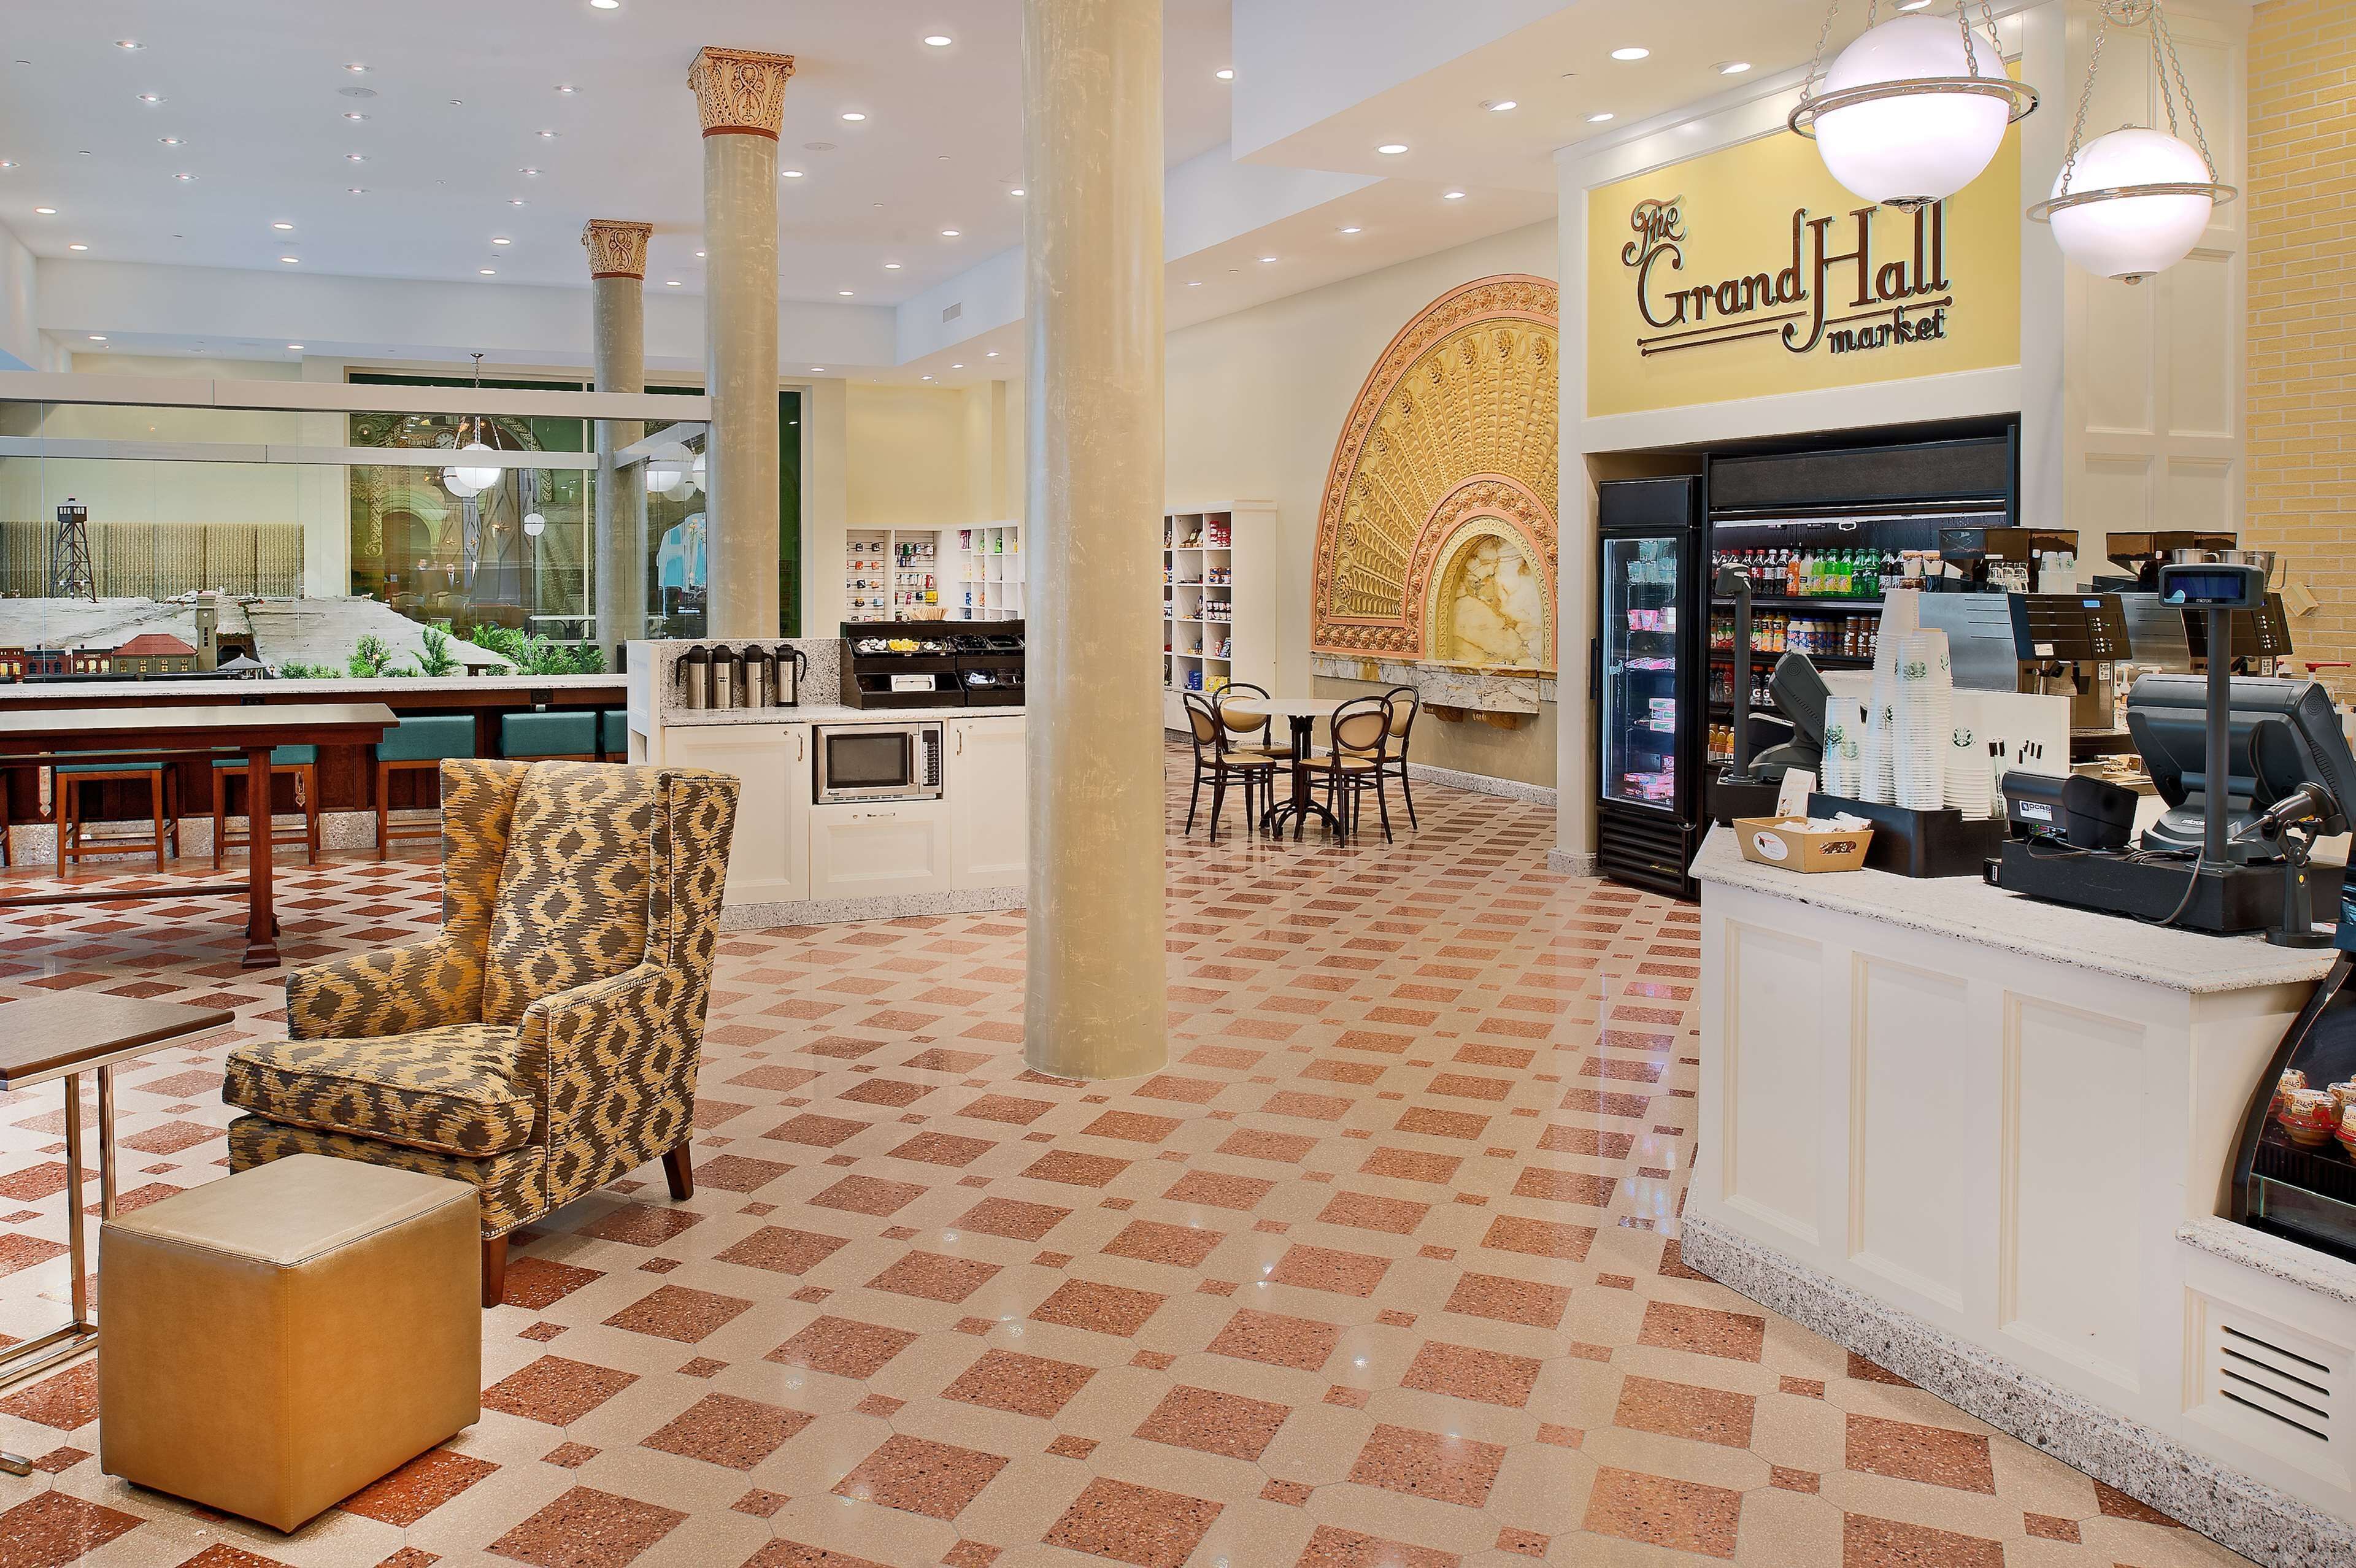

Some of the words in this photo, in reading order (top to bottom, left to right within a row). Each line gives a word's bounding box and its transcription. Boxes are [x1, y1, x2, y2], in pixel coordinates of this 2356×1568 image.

[1622, 194, 1687, 266] The
[1638, 207, 1809, 328] Grand
[1782, 200, 1952, 353] Hall
[1827, 305, 1947, 354] market
